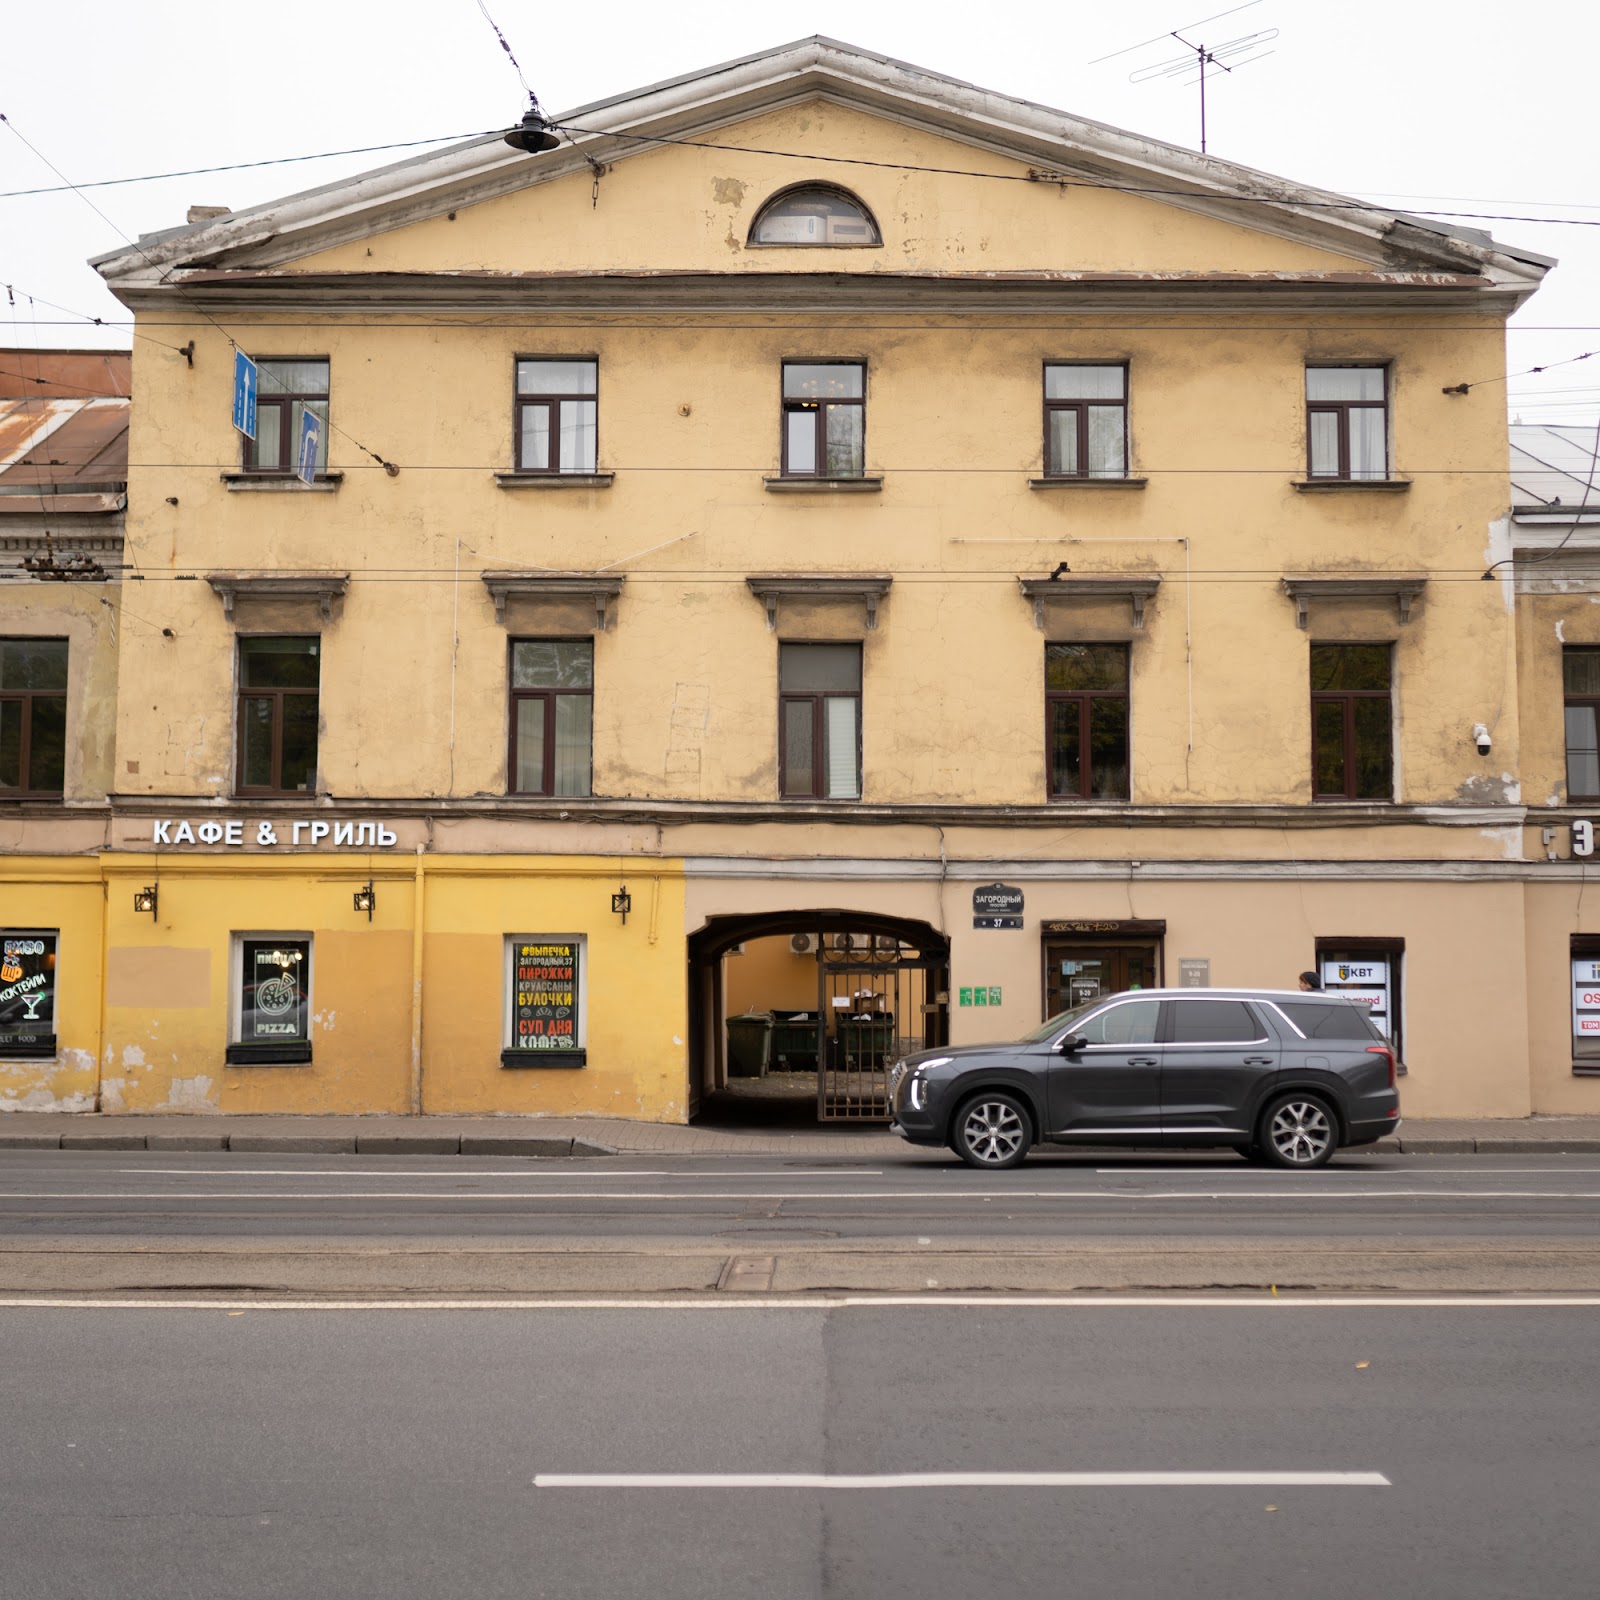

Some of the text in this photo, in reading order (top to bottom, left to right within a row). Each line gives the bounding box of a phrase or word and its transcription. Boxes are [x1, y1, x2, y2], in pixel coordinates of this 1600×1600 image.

[153, 820, 398, 847] КАФЕ & ГРИЛЬ
[976, 895, 1021, 904] ЗАГОРОДНЫЙ
[993, 918, 1003, 928] 37
[521, 946, 570, 957] #ВЫПЕЧКА
[519, 967, 572, 980] ПИРОЖКИ
[0, 973, 46, 1002] КОКТЕЙЛИ
[519, 981, 572, 991] КРУАССАНЫ
[519, 992, 572, 1006] БУЛОЧКИ
[257, 1023, 296, 1034] PIZZA
[519, 1020, 573, 1036] СУП ДНЯ
[519, 1035, 558, 1048] КОФЕ
